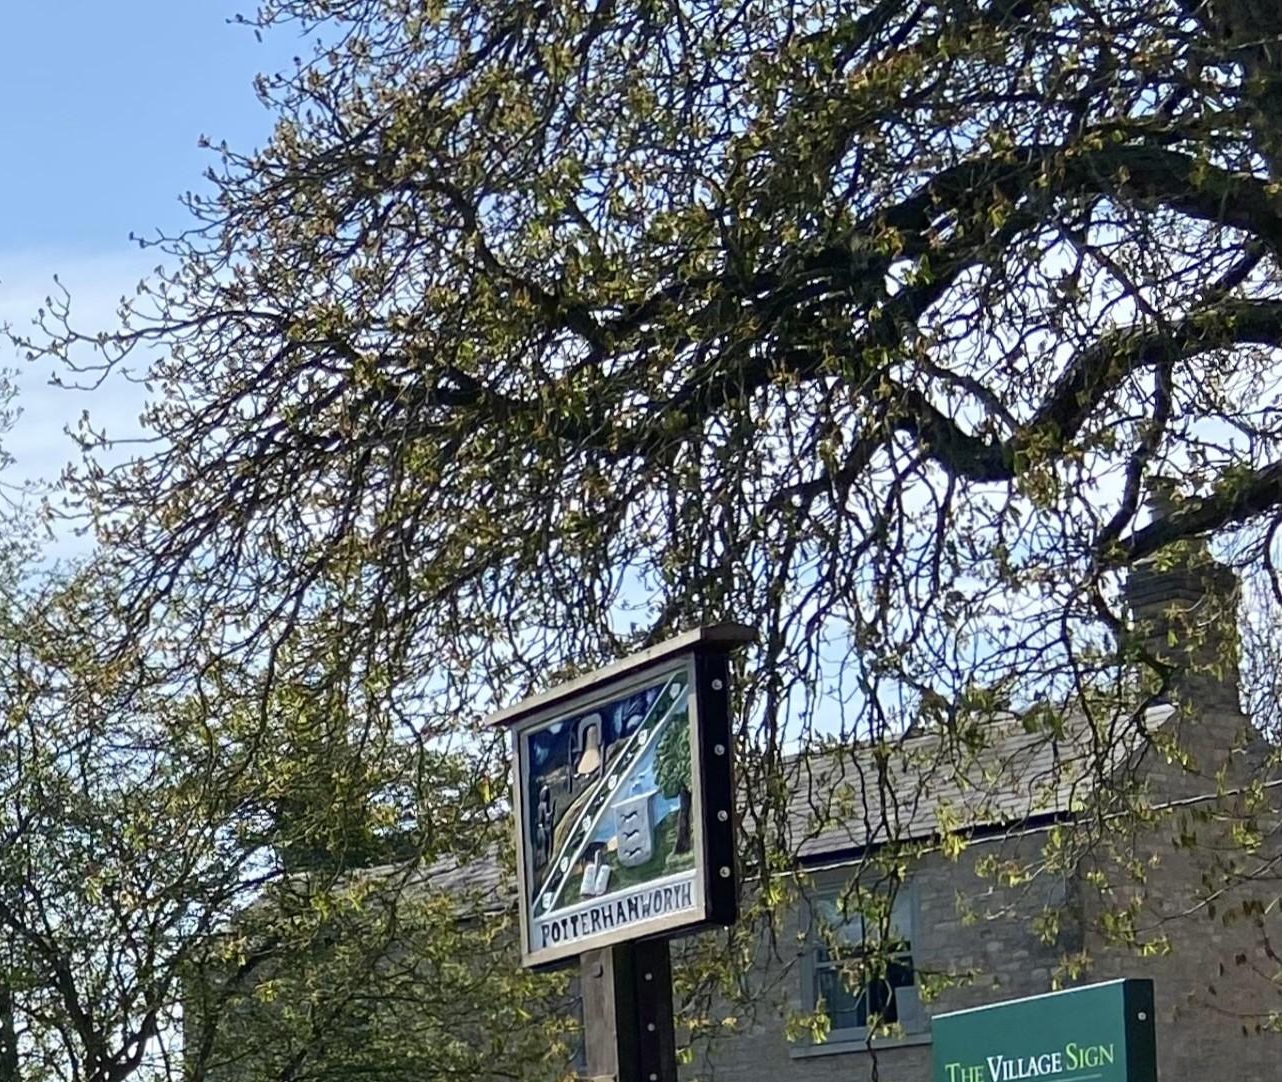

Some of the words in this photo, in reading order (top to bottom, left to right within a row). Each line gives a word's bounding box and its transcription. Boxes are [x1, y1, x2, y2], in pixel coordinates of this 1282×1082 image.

[541, 882, 692, 948] POTTERHANWORTH
[987, 1052, 1063, 1082] VILLAGE
[1065, 1042, 1114, 1071] SIGN
